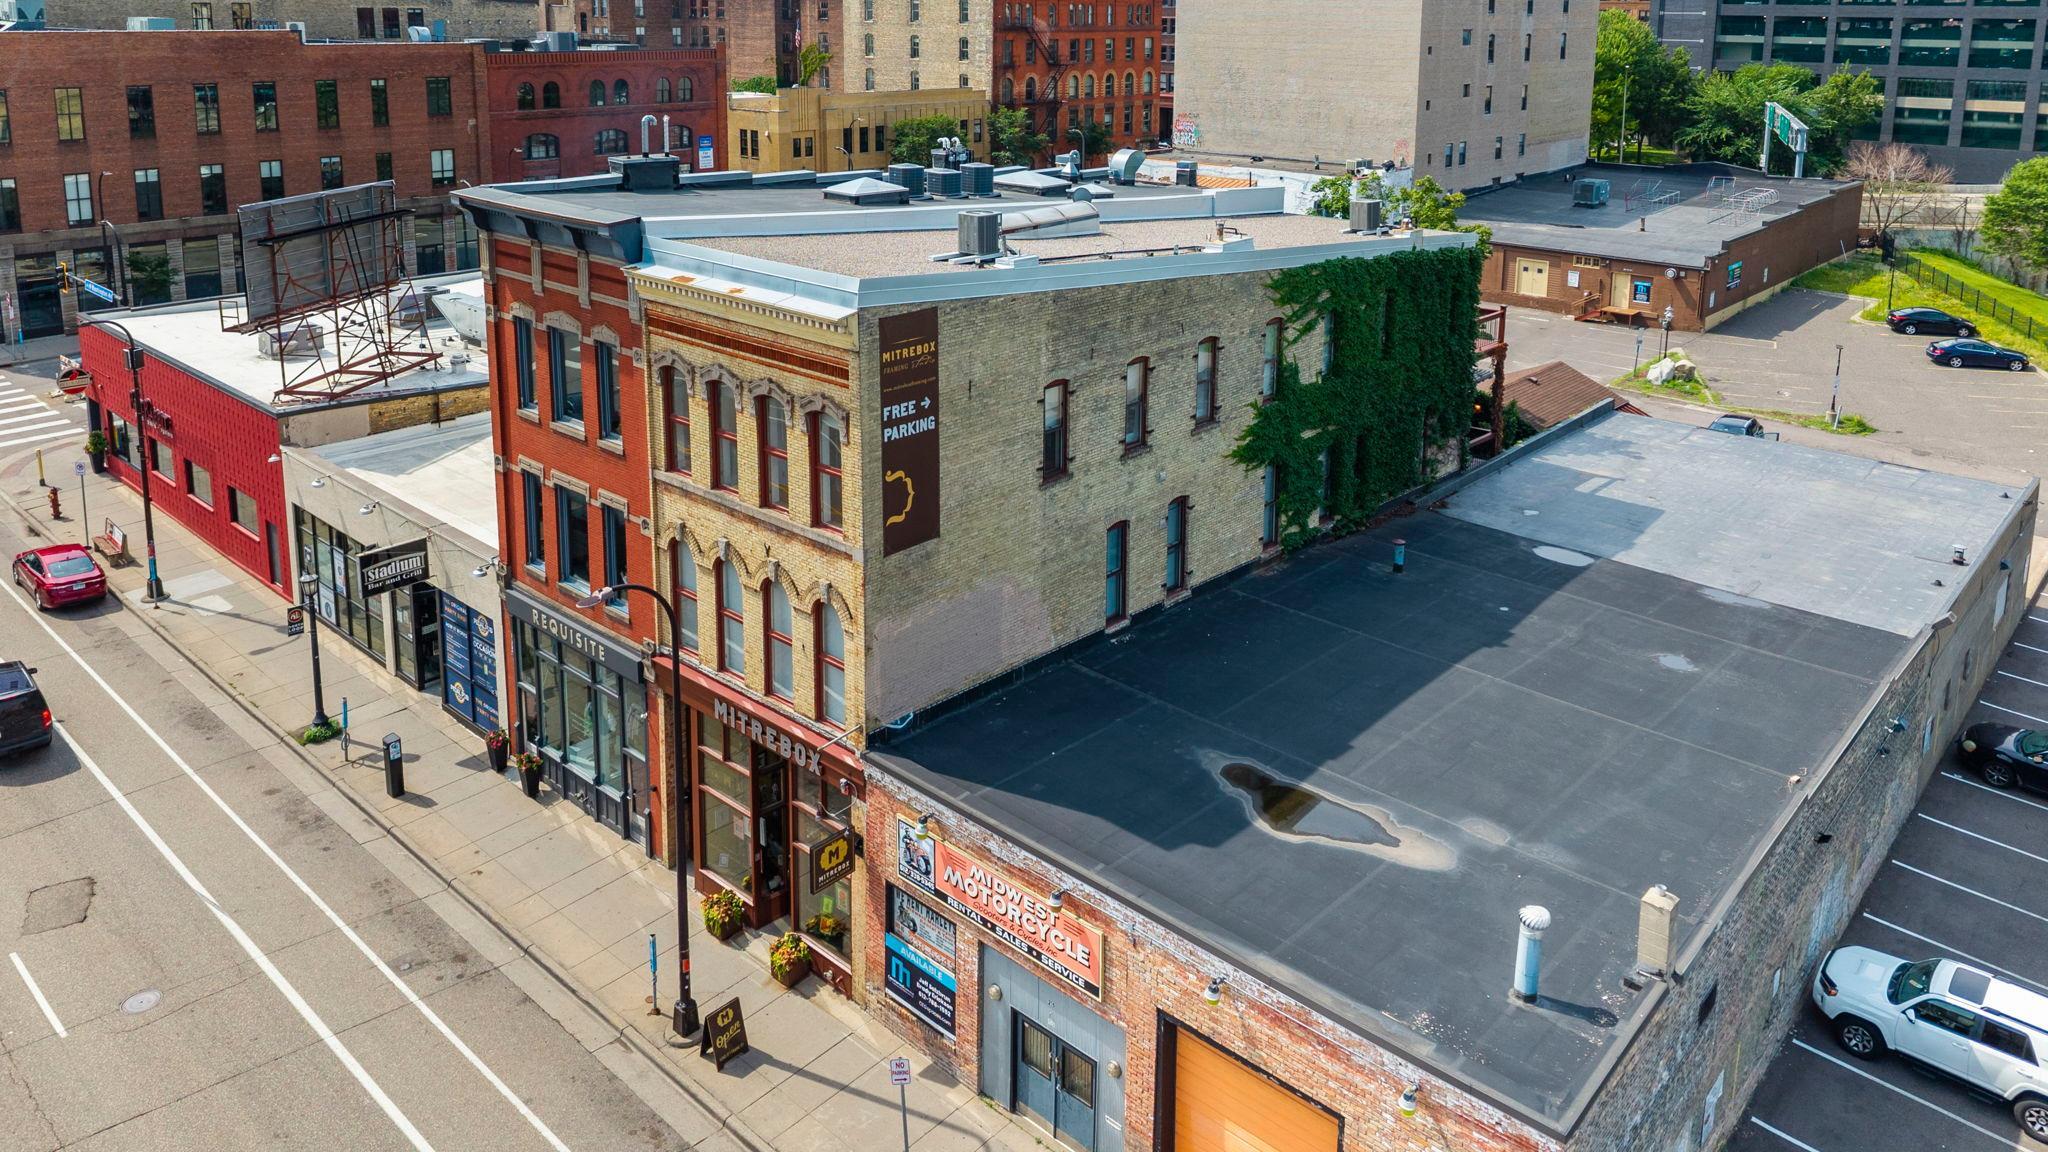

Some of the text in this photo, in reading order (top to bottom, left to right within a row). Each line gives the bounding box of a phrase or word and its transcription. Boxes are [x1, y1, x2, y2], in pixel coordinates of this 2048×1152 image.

[882, 341, 936, 363] MITREBOX
[883, 400, 917, 422] FREE
[883, 415, 936, 443] PARKING
[368, 556, 421, 582] Stadium
[368, 569, 422, 590] Bar and Grill
[532, 608, 605, 661] REQUISITE
[714, 697, 821, 777] MITREBOX
[818, 861, 850, 883] MITREBOX
[970, 864, 1059, 926] MIDWEST
[943, 865, 1091, 968] MOTORCYCLE
[972, 901, 1008, 928] Scooters
[1009, 923, 1016, 931] &
[947, 896, 1086, 988] RENTAL SALES SERVICE
[900, 947, 943, 981] AVAILABLE
[895, 1061, 905, 1069] NO
